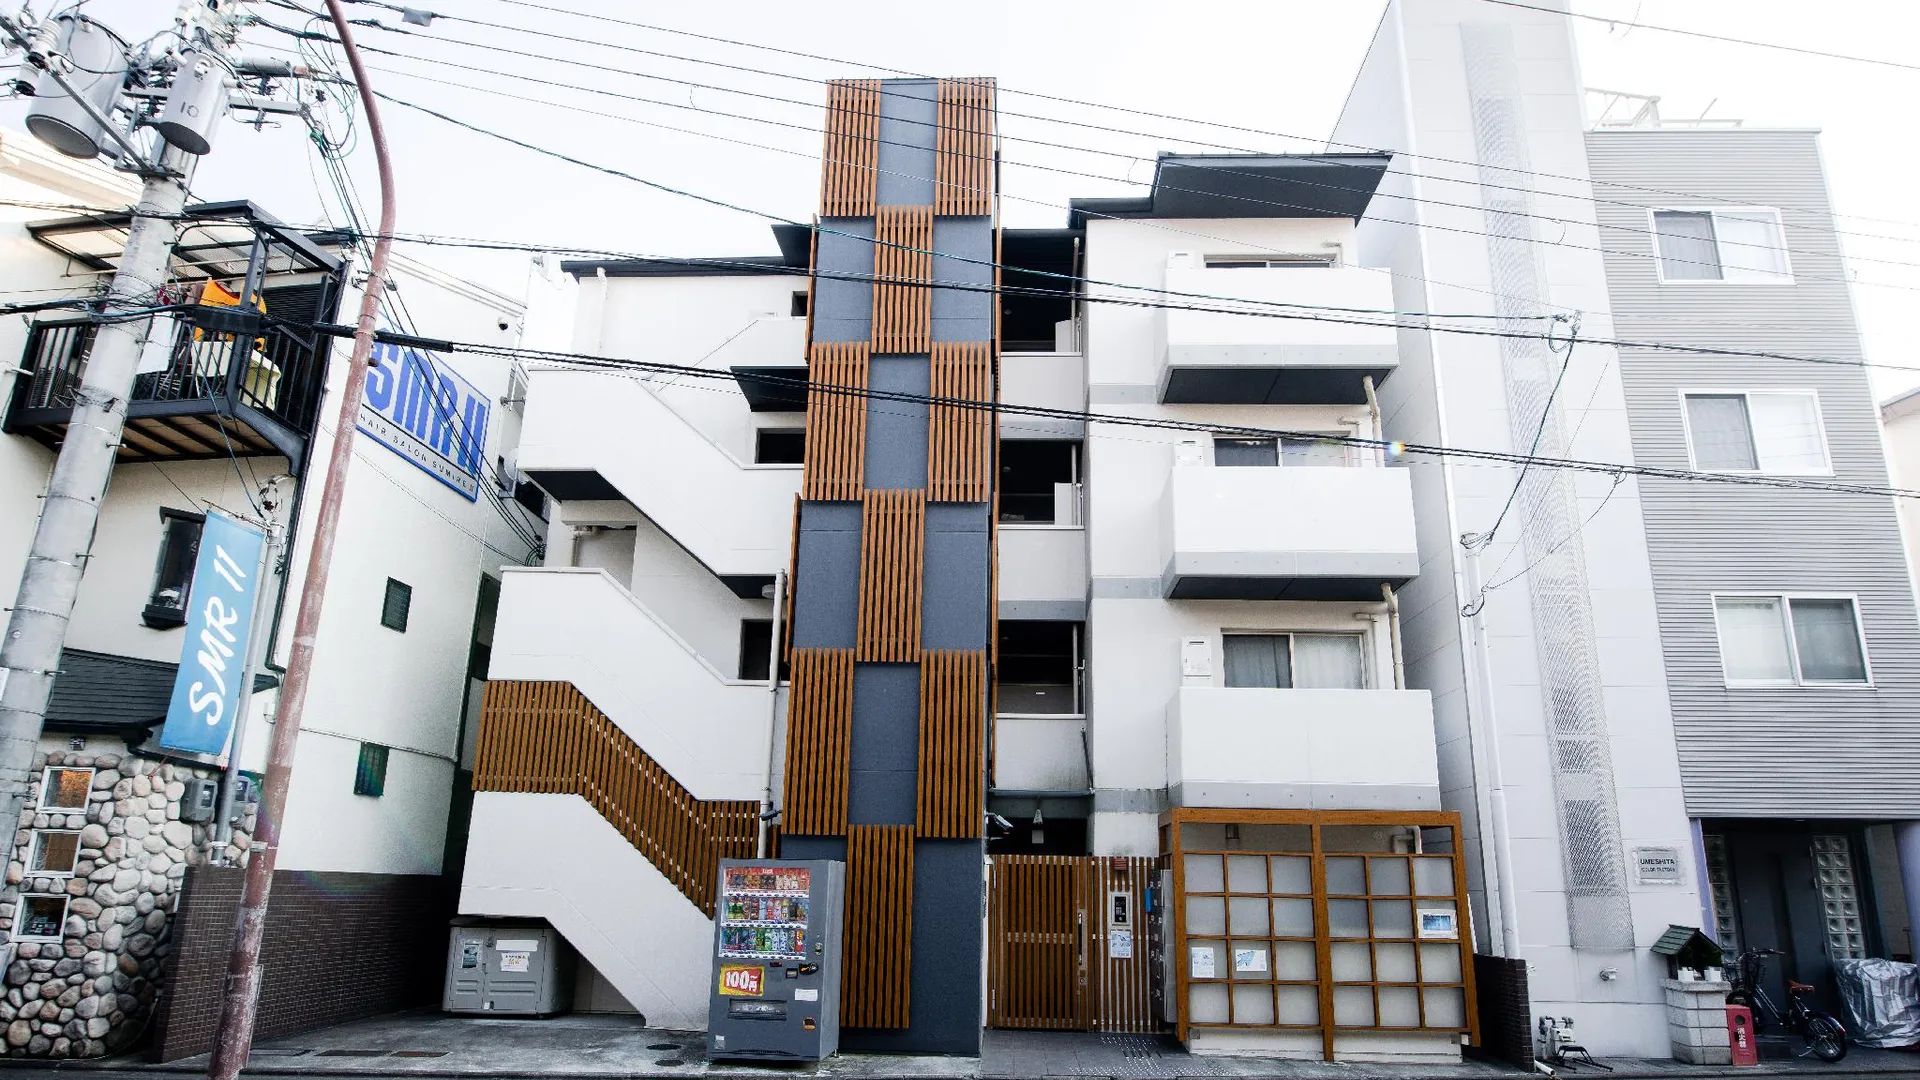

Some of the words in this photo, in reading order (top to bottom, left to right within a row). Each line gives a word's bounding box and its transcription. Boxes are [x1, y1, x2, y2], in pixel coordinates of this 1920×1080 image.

[180, 101, 200, 118] 10
[360, 413, 387, 437] HAIR
[393, 435, 428, 463] SALON
[432, 461, 468, 488] SUMIRE
[188, 595, 239, 726] SMR
